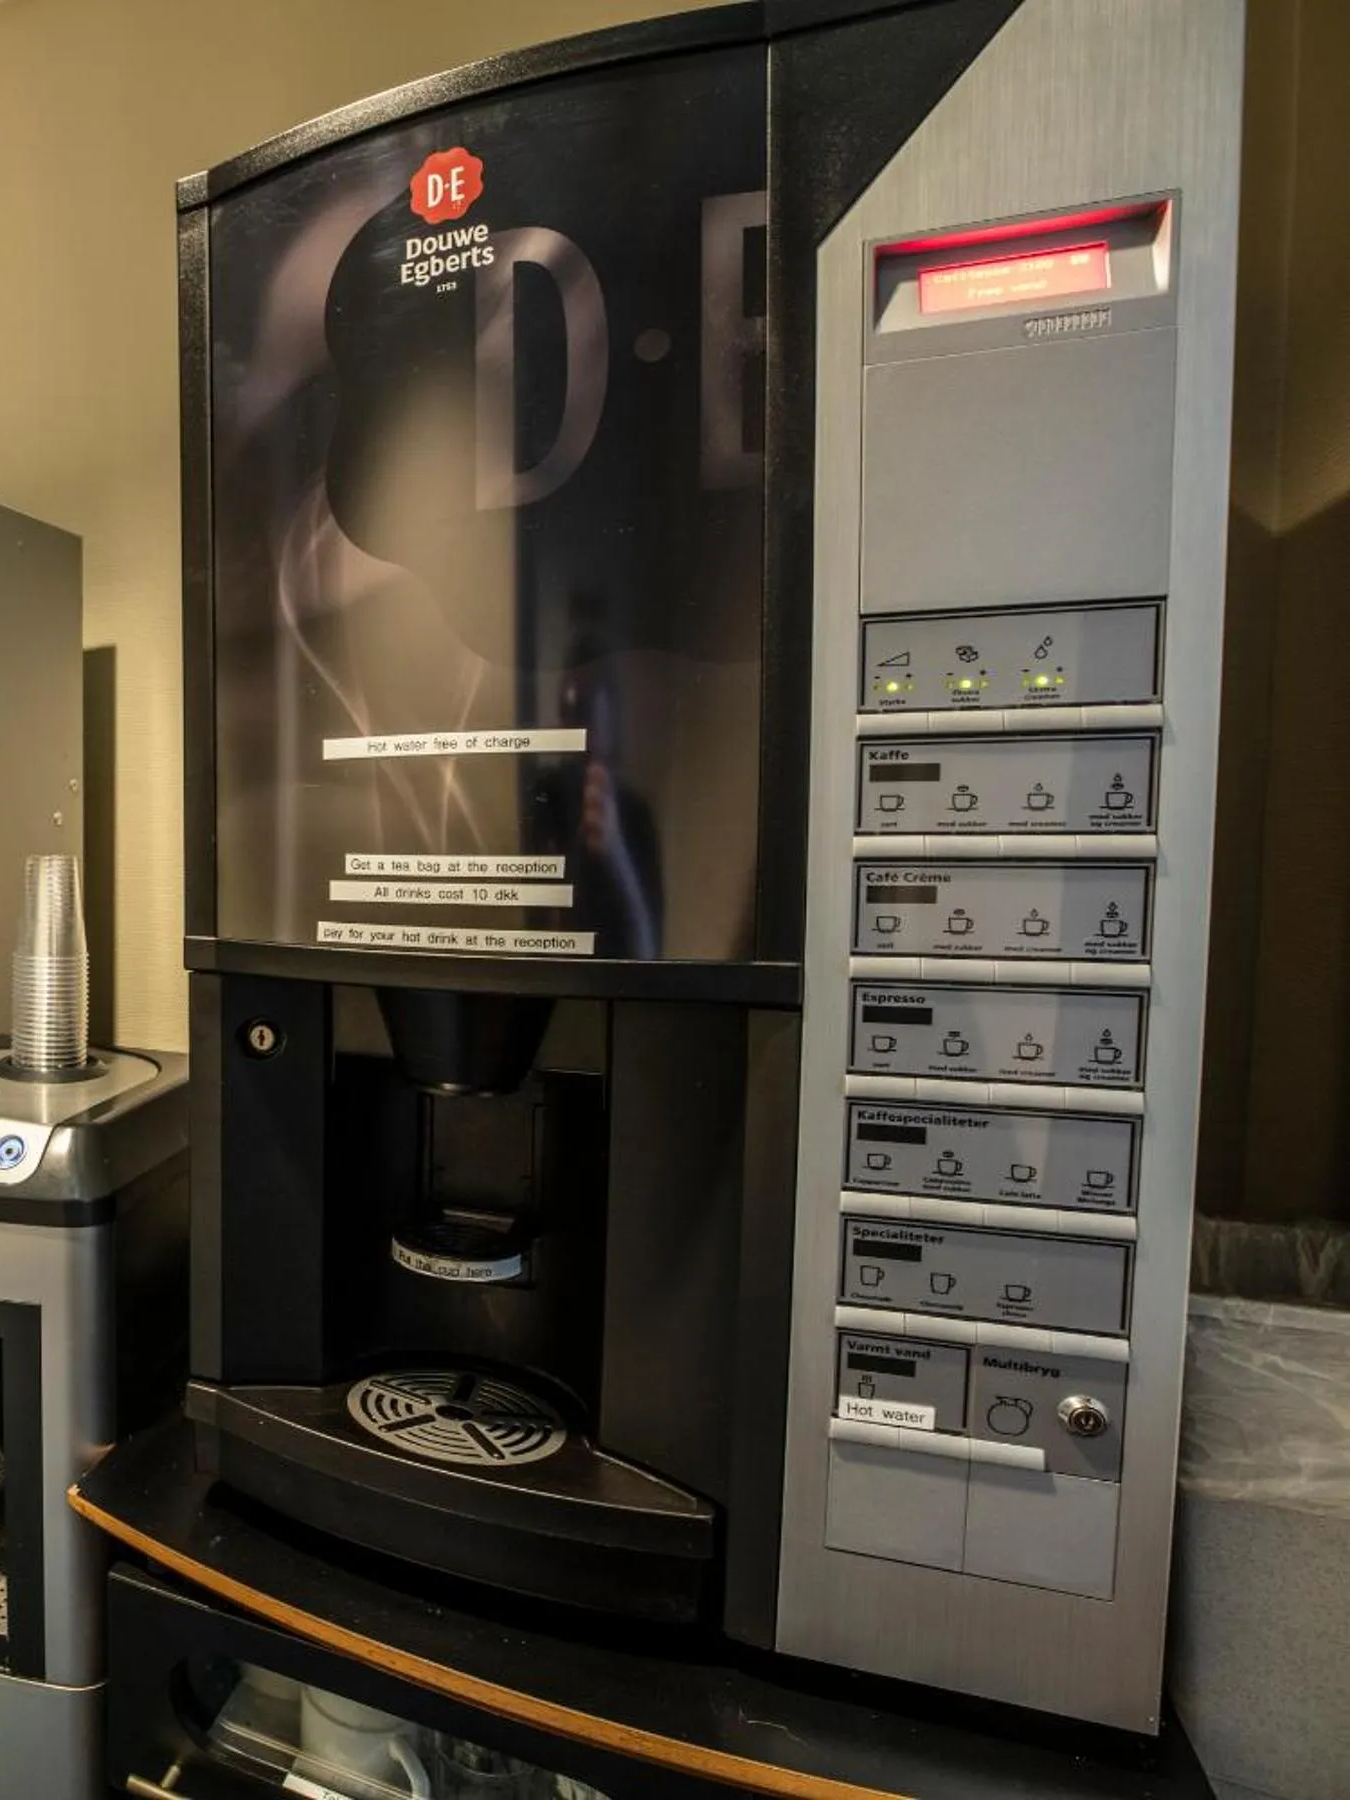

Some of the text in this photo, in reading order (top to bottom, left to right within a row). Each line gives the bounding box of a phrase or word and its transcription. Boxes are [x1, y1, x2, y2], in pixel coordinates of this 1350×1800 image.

[405, 223, 490, 261] Douwe
[400, 245, 495, 287] Egberts
[465, 736, 478, 749] of
[484, 735, 531, 750] charge
[868, 750, 910, 761] Kaffe
[377, 862, 385, 871] a
[391, 860, 410, 872] tea
[416, 859, 441, 874] bag
[447, 861, 461, 873] at
[467, 861, 489, 873] the
[495, 861, 558, 875] reception
[373, 885, 520, 902] All drinks cost 10 dkk
[348, 927, 364, 940] for
[369, 930, 395, 942] your
[401, 930, 421, 943] hot
[427, 931, 459, 945] drink
[465, 934, 478, 946] at
[485, 934, 506, 947] the
[513, 935, 576, 950] reception
[861, 992, 927, 1005] Espresso
[857, 1110, 990, 1129] Kaffespecialiteter
[852, 1226, 945, 1245] Specialiteter
[847, 1340, 932, 1360] Varmt vand
[982, 1356, 1061, 1379] Multibryg
[845, 1402, 927, 1424] Hot water
